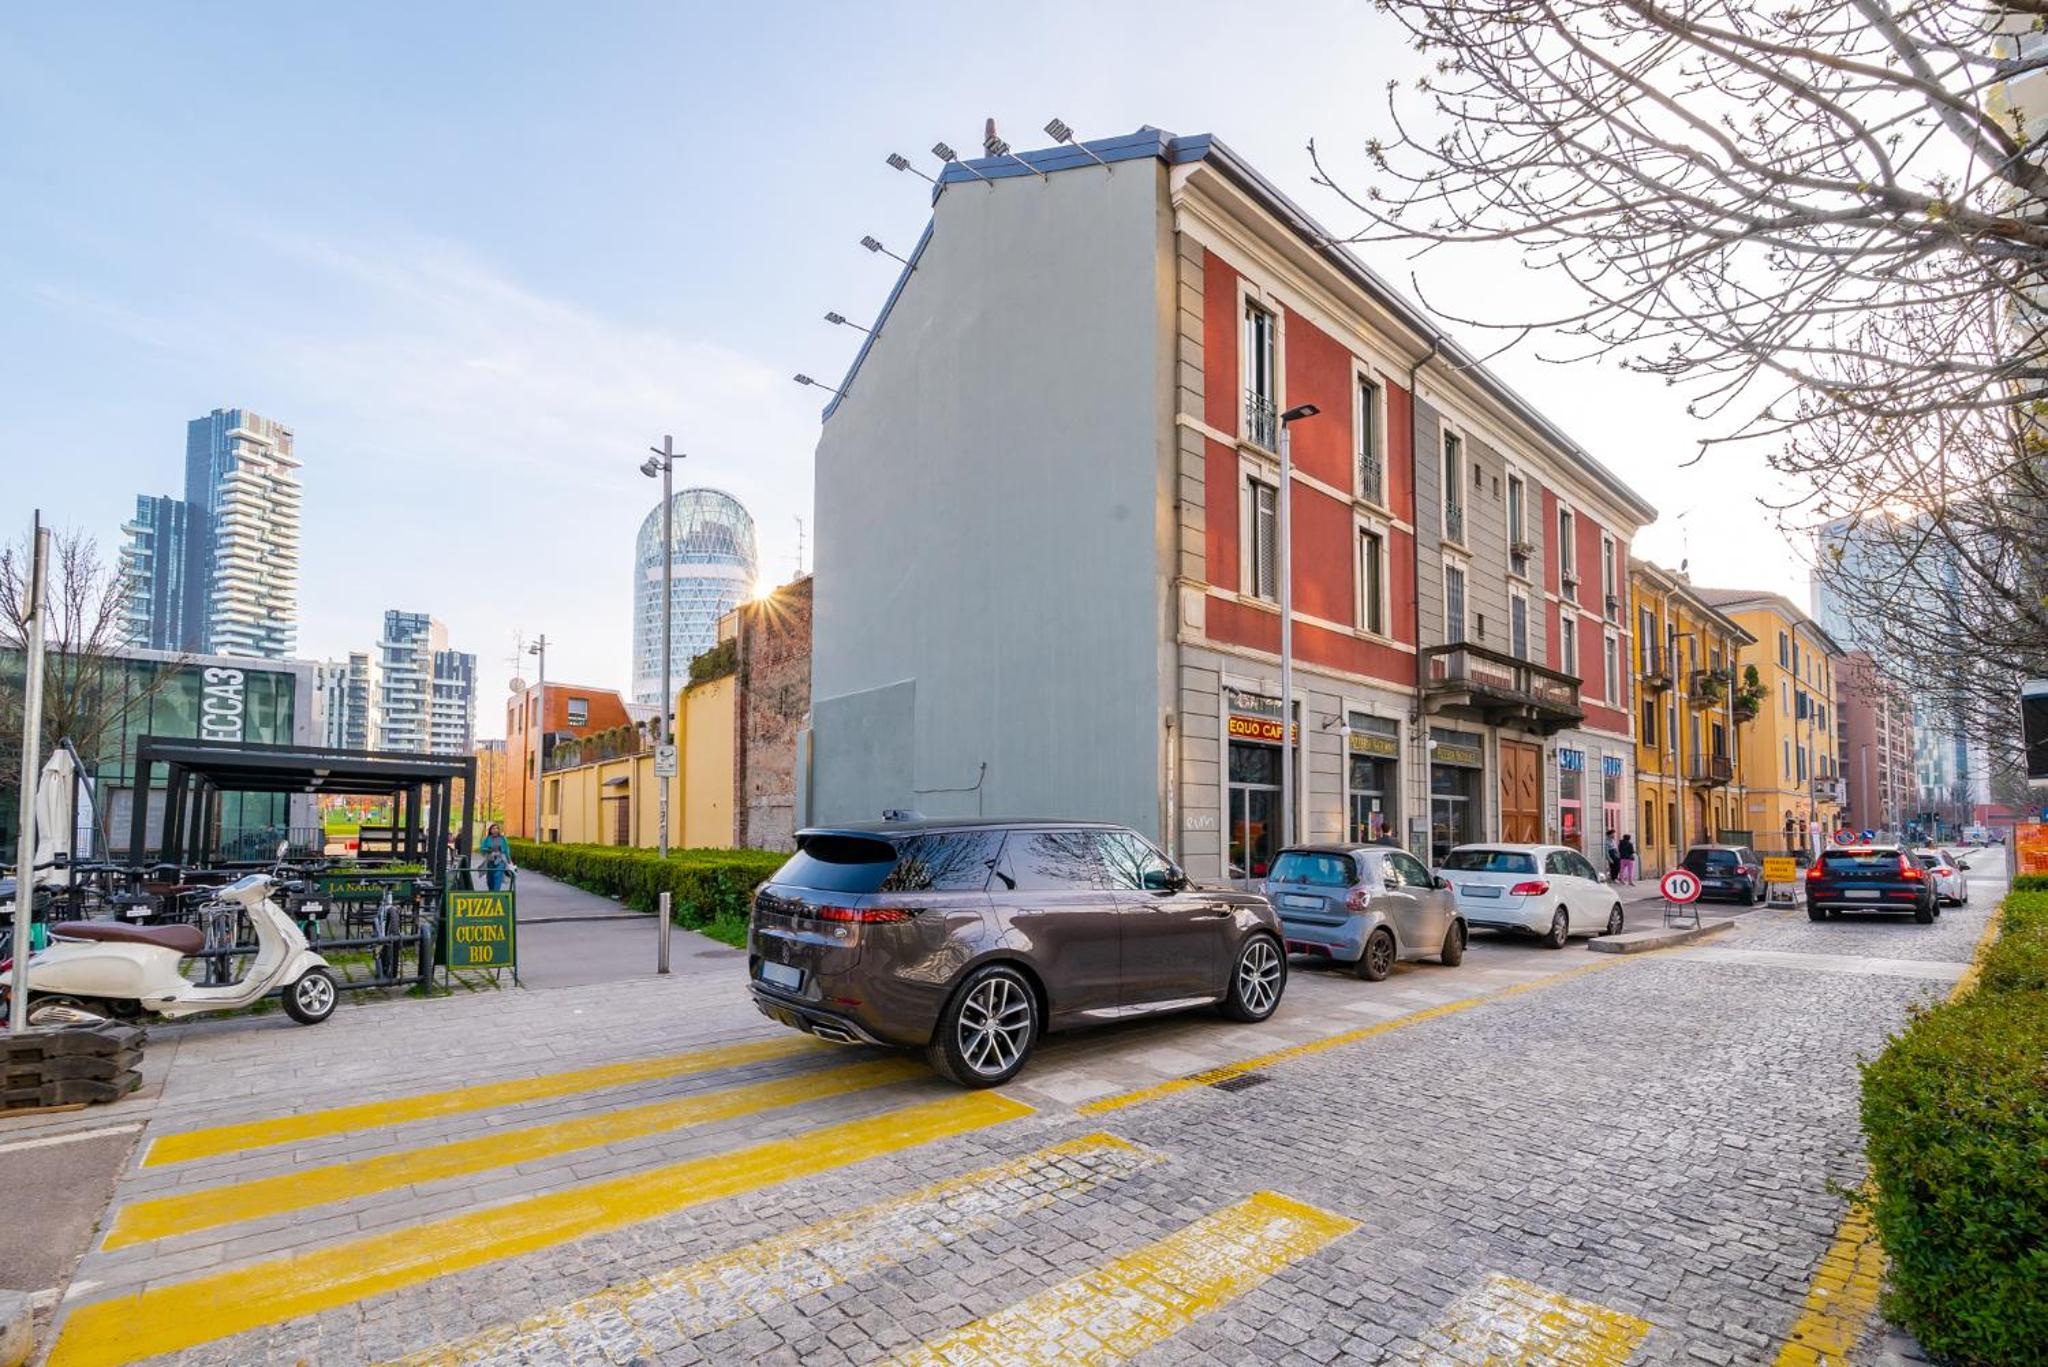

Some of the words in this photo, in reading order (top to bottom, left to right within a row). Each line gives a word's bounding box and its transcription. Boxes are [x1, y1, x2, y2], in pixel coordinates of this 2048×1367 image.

[202, 667, 244, 742] ECCA3
[1230, 720, 1260, 735] EQUO
[1671, 879, 1690, 894] 10
[456, 898, 504, 917] PIZZA
[456, 925, 506, 943] CUCINA
[470, 945, 493, 962] BIO
